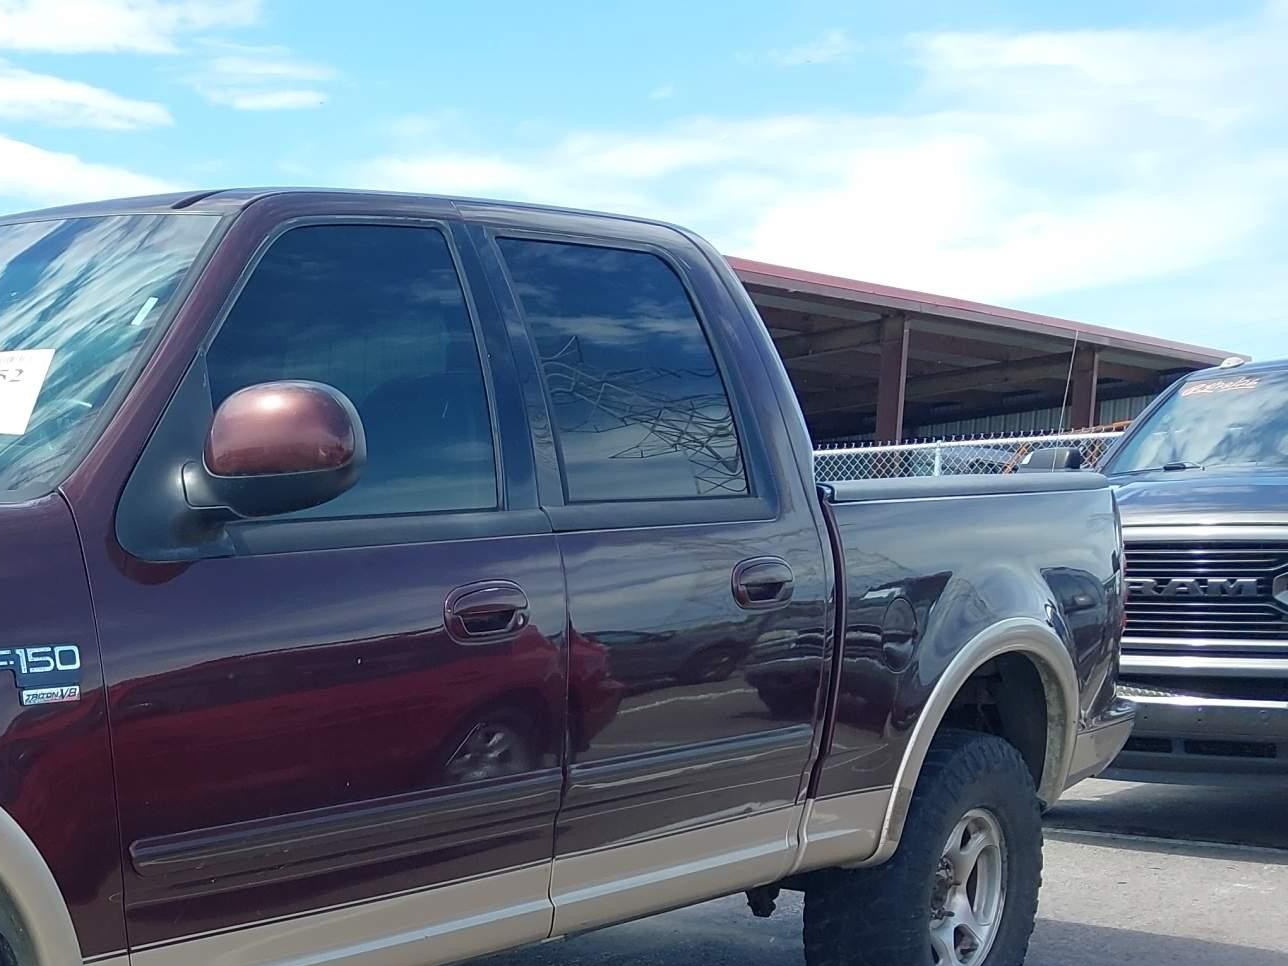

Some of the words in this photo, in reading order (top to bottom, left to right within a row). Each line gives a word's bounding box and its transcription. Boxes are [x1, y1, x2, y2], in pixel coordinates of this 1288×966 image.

[1124, 578, 1258, 597] RAM
[24, 691, 59, 703] TRITON
[60, 687, 78, 699] V8
